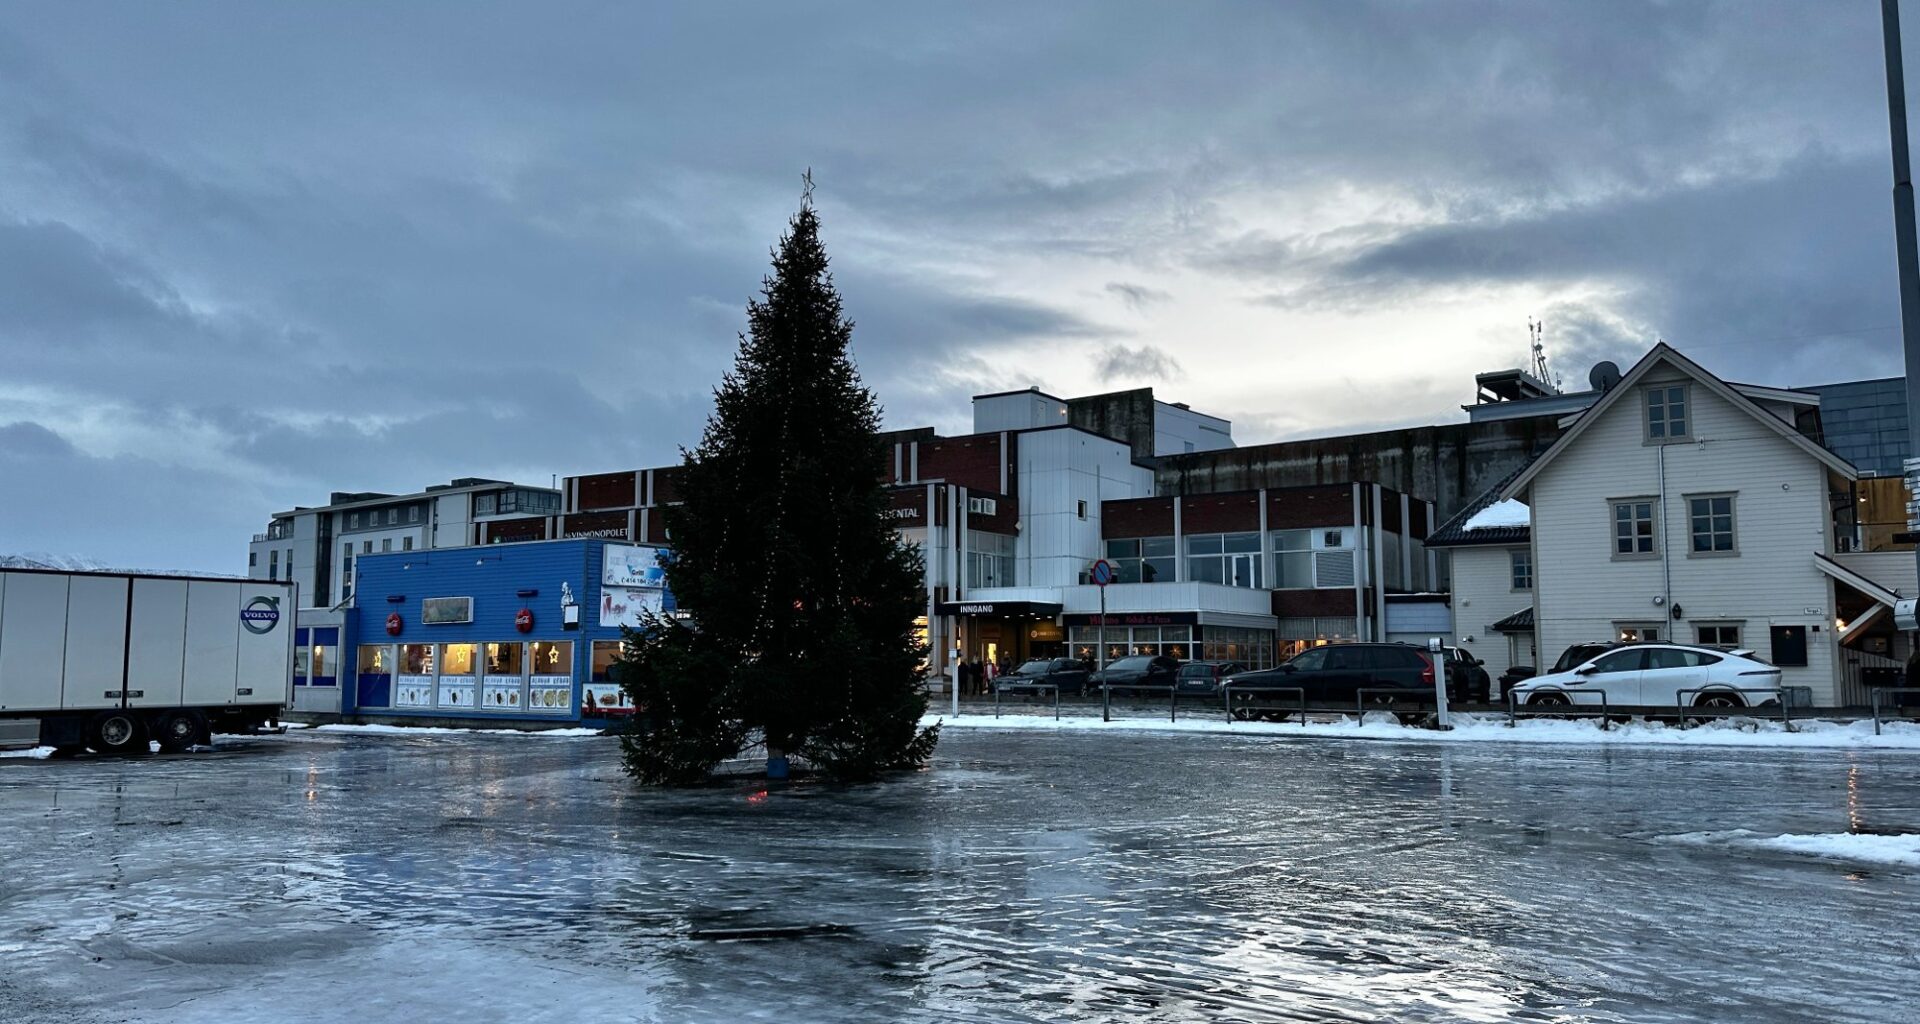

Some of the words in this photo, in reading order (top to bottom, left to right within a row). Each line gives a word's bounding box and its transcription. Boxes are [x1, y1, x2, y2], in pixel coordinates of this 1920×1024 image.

[571, 528, 628, 538] VINMONOPOLET
[960, 604, 994, 614] INNGANG
[244, 611, 277, 619] VOLVO
